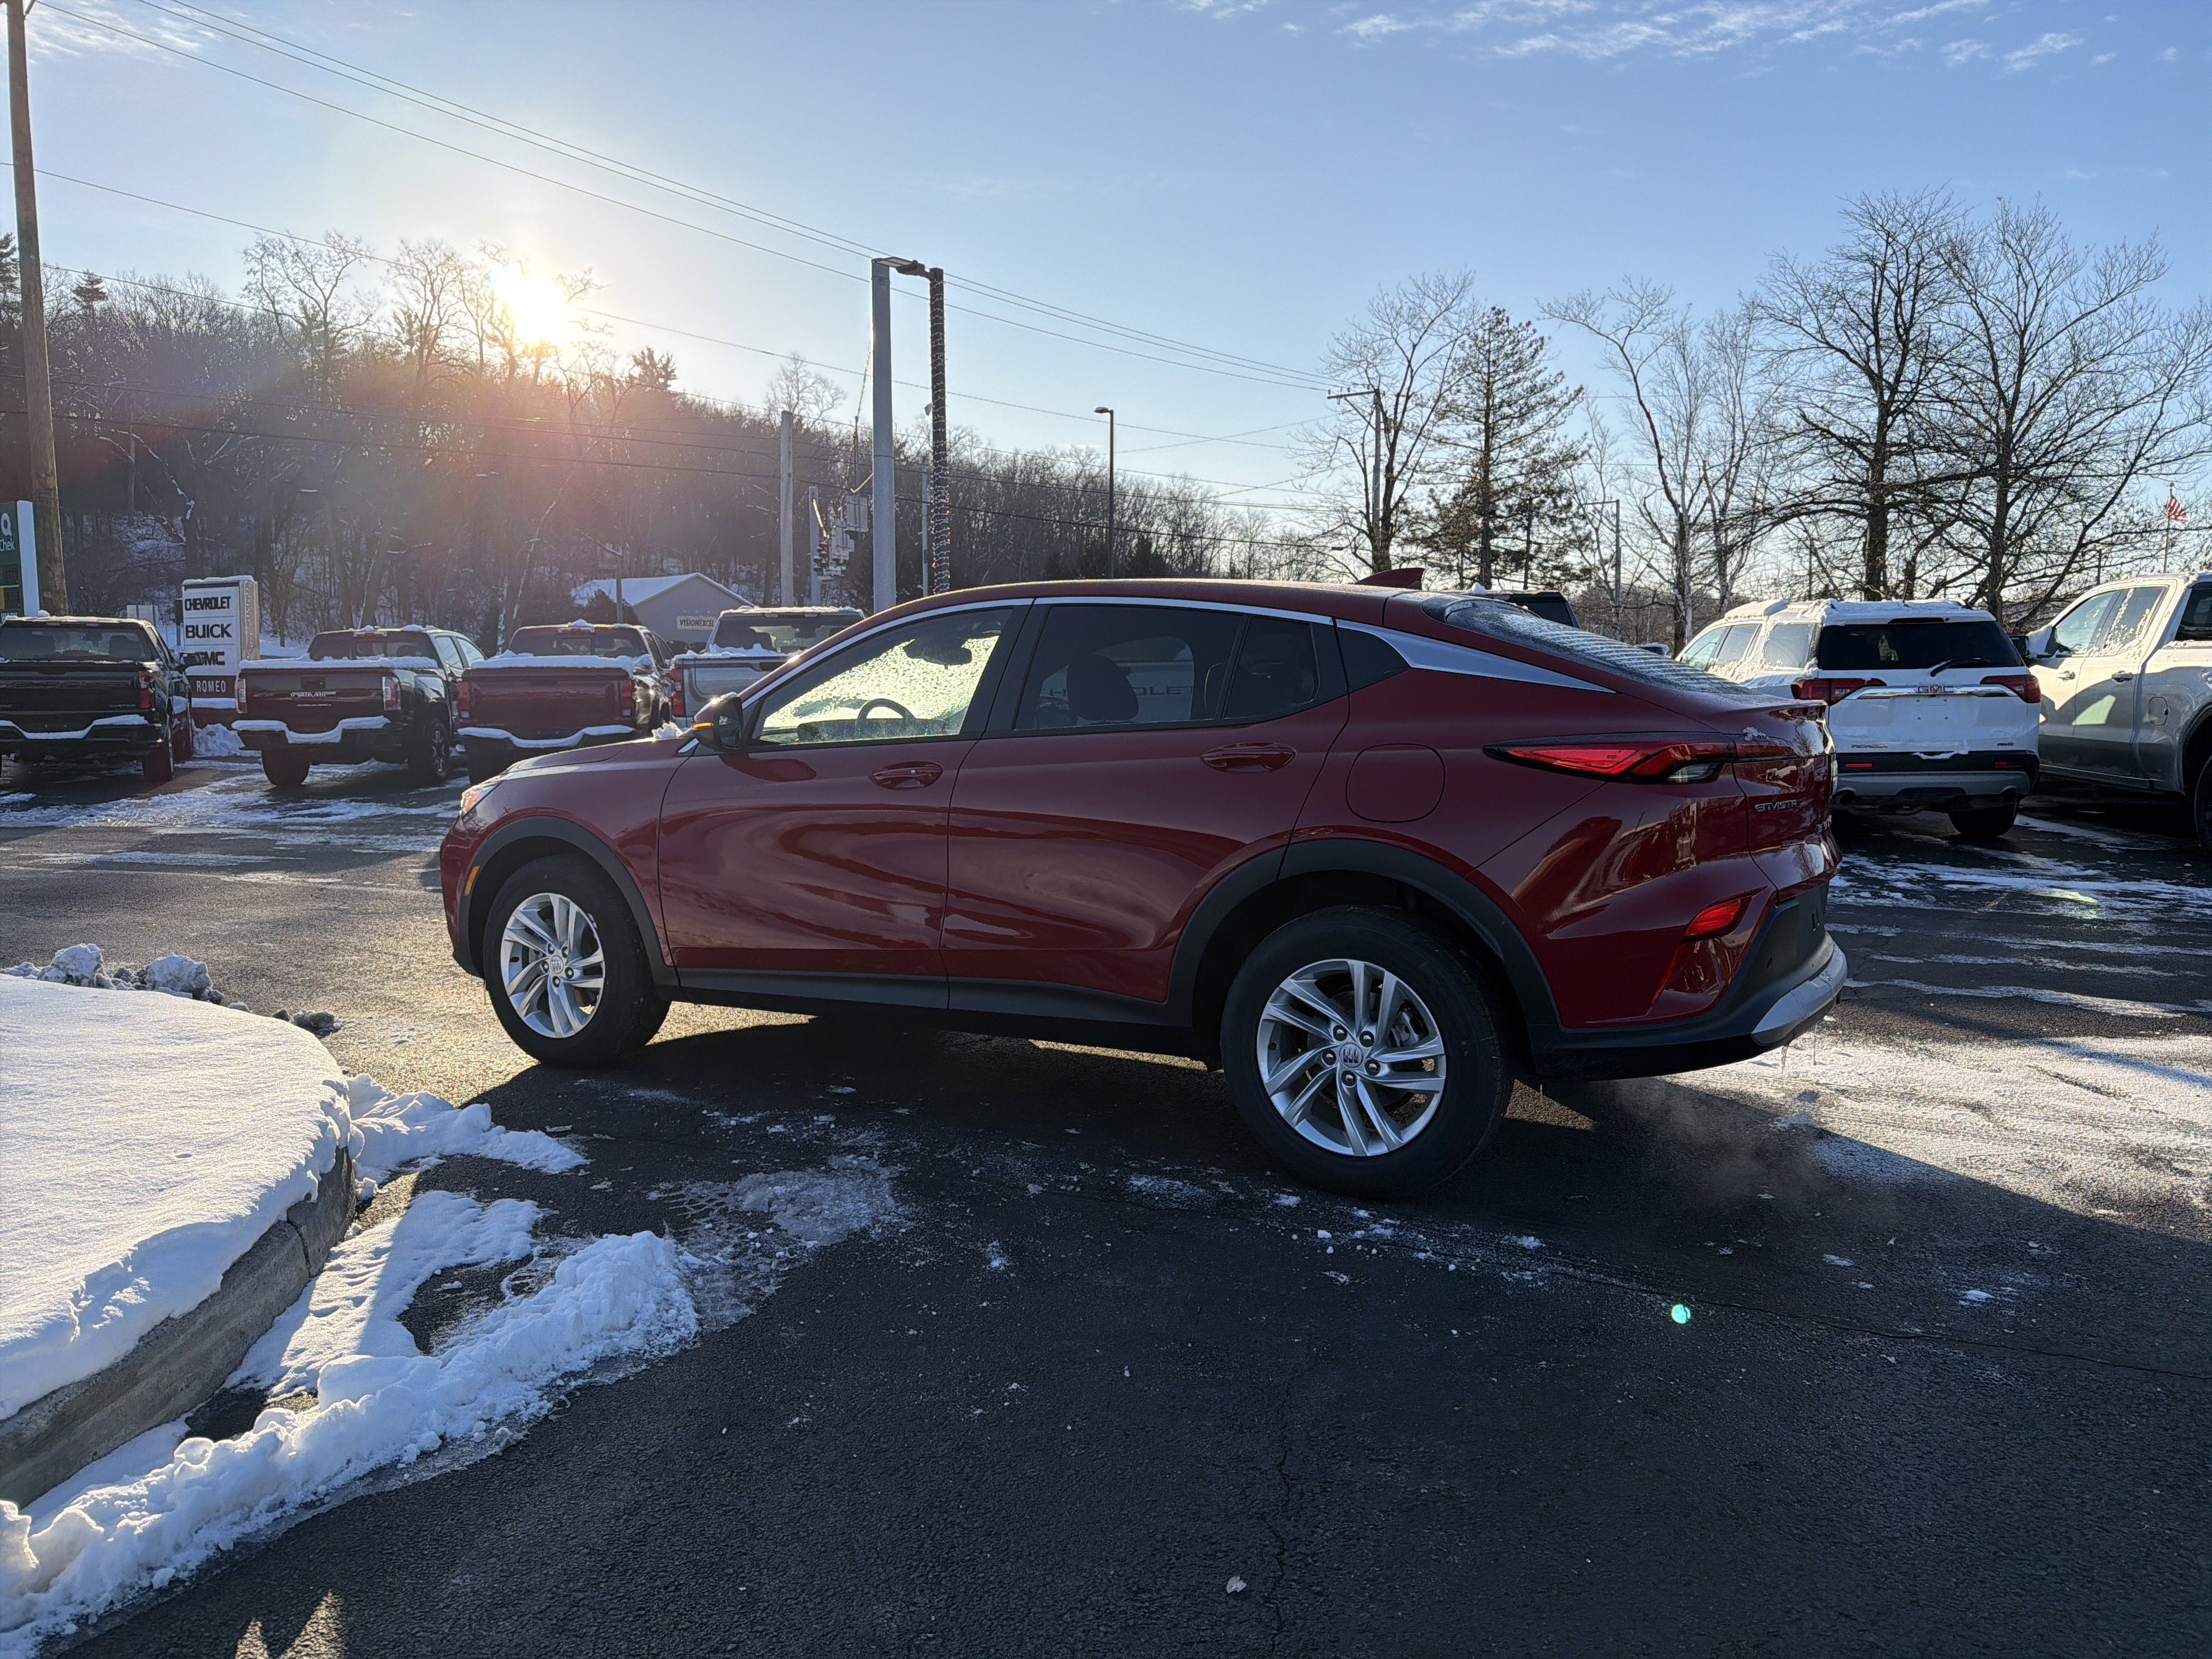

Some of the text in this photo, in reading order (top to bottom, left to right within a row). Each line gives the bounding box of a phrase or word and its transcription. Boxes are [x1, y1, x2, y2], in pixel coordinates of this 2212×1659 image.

[184, 596, 231, 611] CHEVROLET
[185, 624, 233, 639] BUICK
[196, 681, 226, 692] ROMEO
